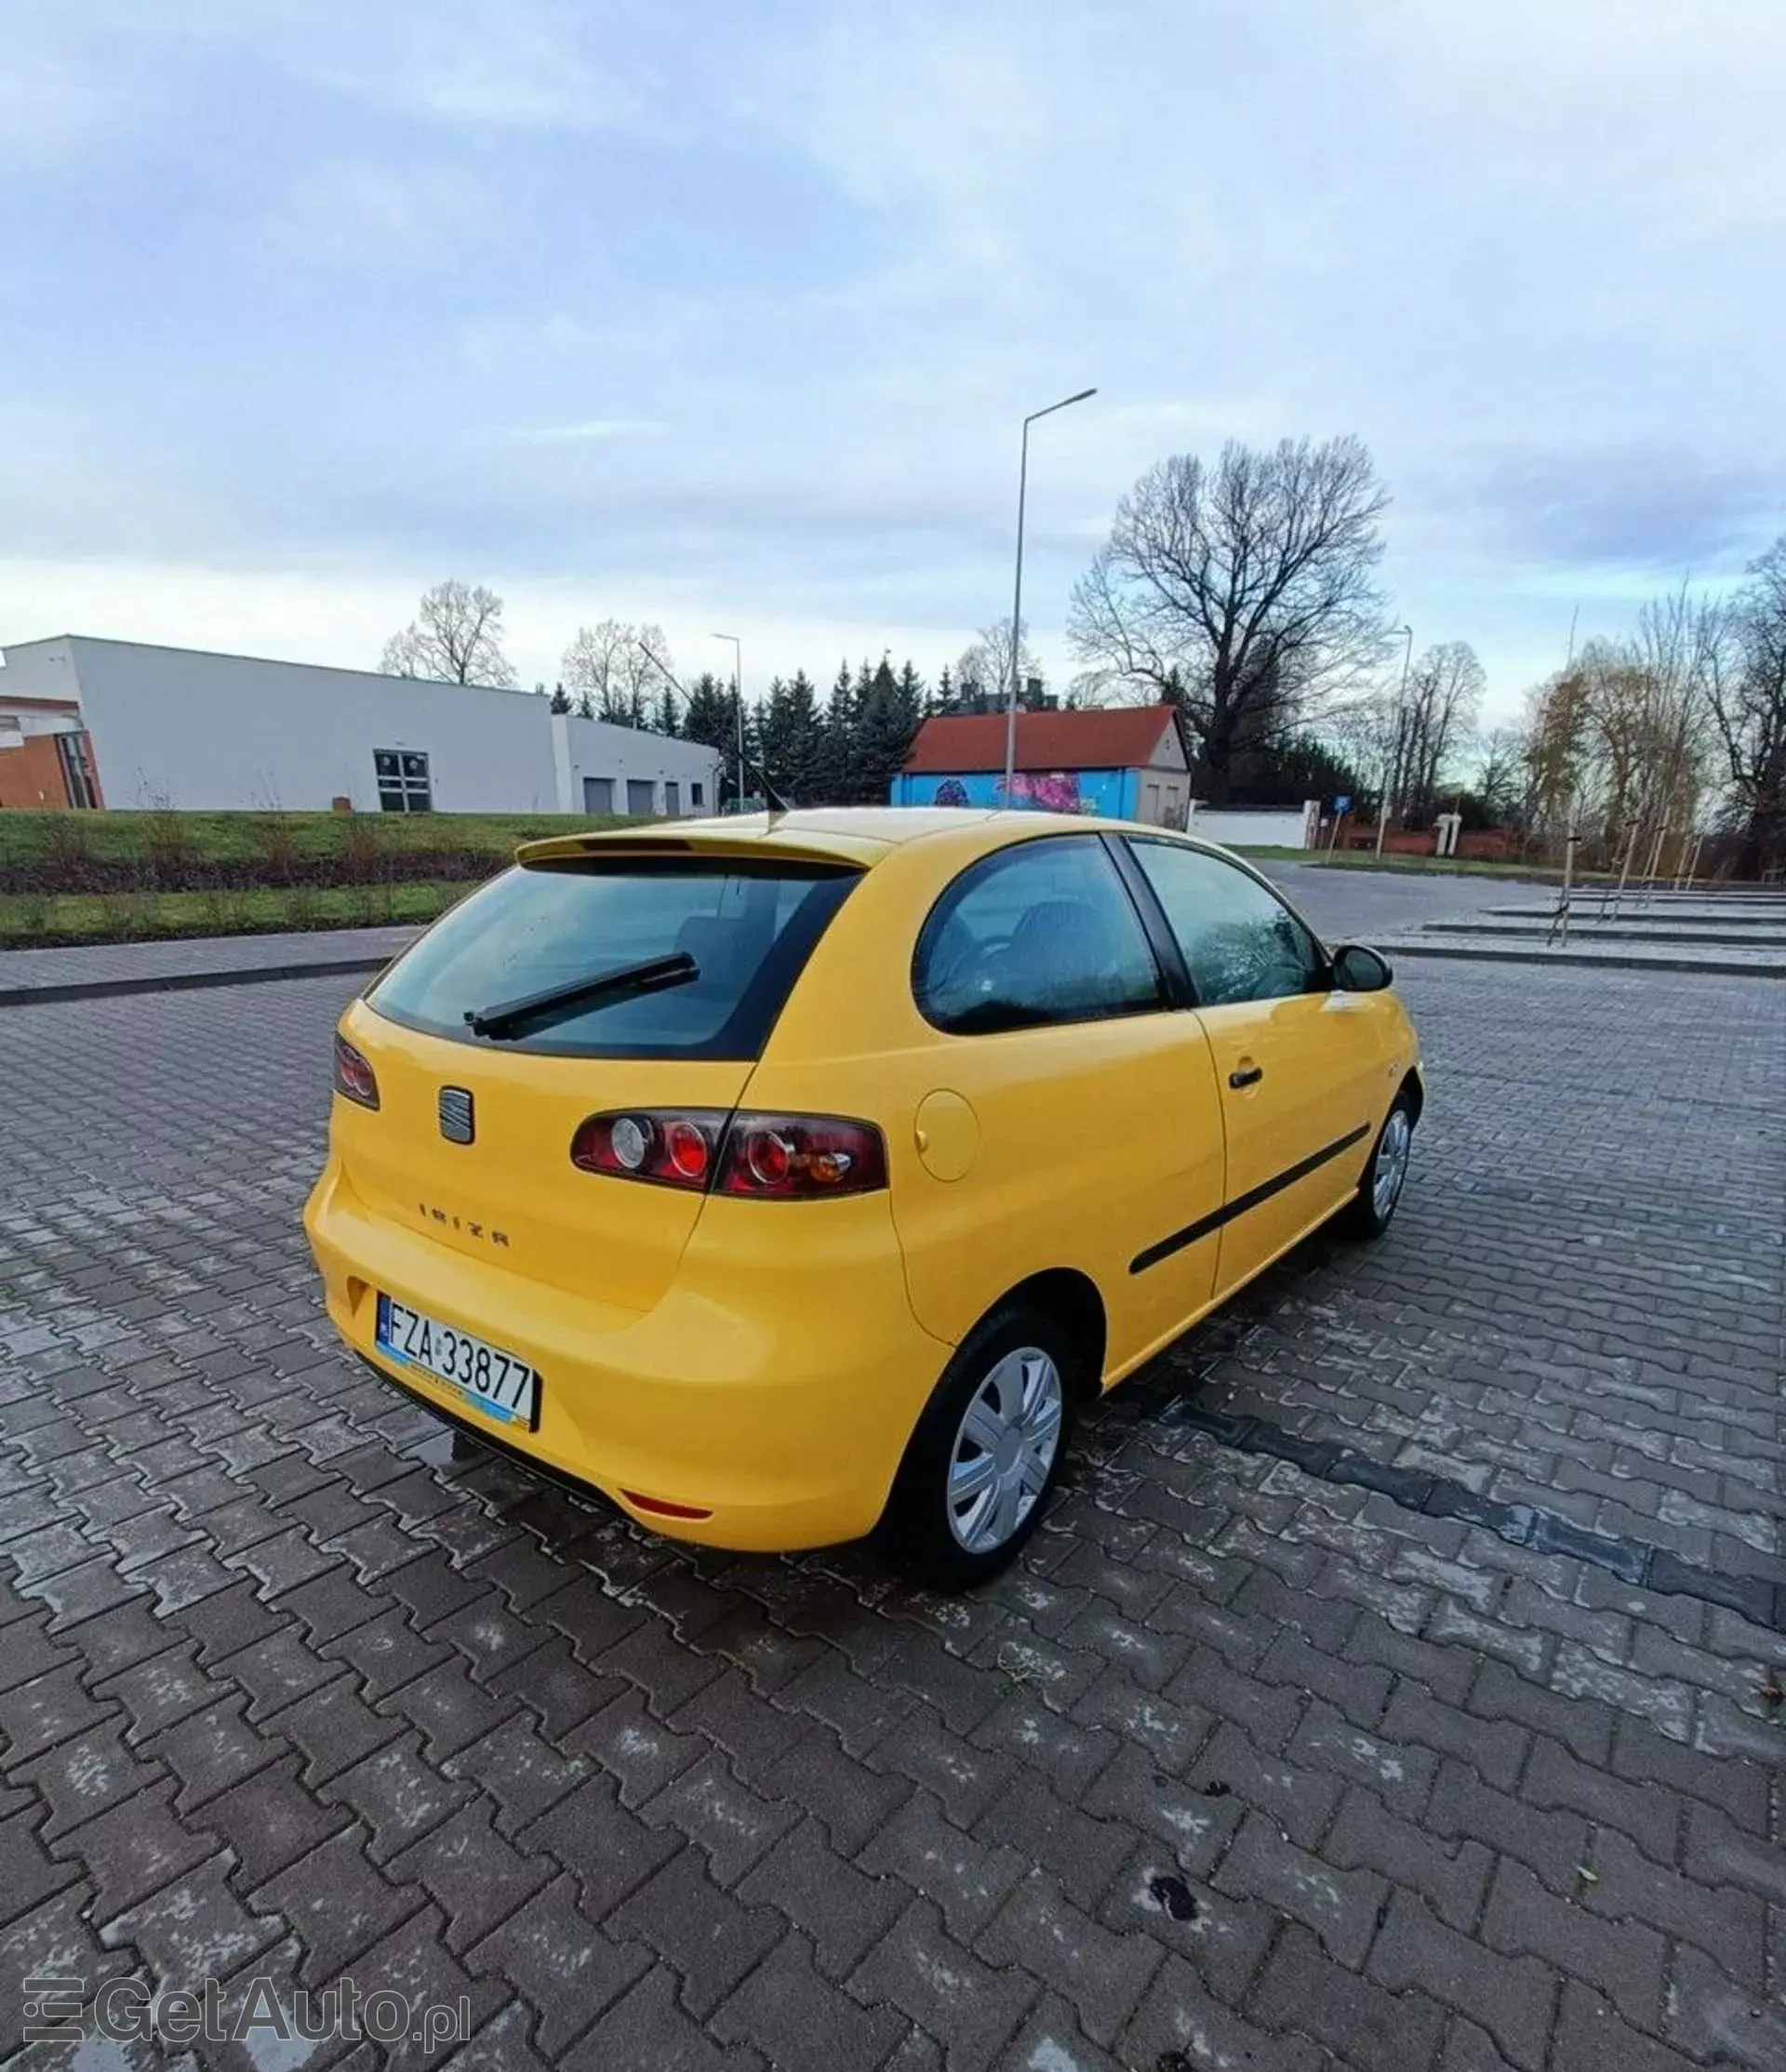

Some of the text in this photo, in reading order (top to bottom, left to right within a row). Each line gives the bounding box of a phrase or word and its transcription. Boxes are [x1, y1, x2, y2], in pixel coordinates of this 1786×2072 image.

[419, 1202, 510, 1247] IBIZA
[391, 1302, 433, 1366] FZA
[443, 1331, 530, 1409] 33877
